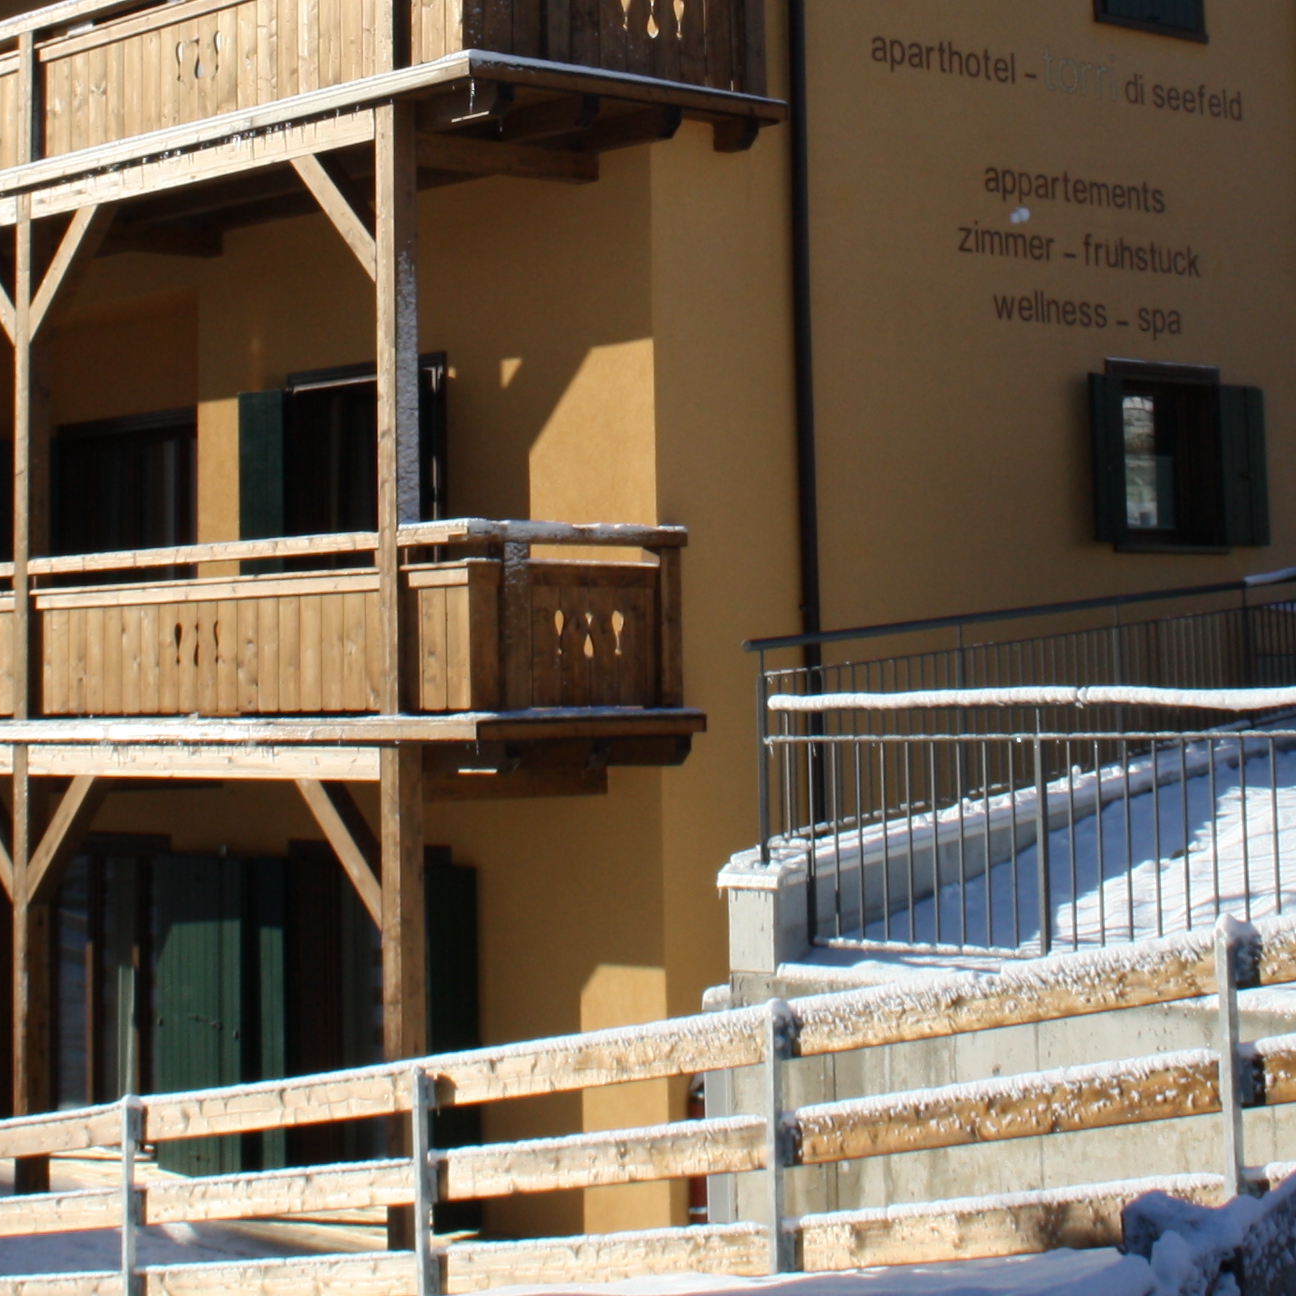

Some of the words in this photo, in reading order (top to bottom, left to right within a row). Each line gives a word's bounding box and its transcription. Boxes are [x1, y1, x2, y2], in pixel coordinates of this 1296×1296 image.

[871, 35, 1016, 84] aparthotel
[1042, 45, 1118, 100] torri
[1125, 74, 1145, 105] di
[1152, 82, 1243, 120] seefeld
[984, 167, 1165, 213] appartements
[958, 221, 1054, 262] zimmer
[993, 290, 1108, 328] wellness
[1138, 307, 1182, 341] spa
